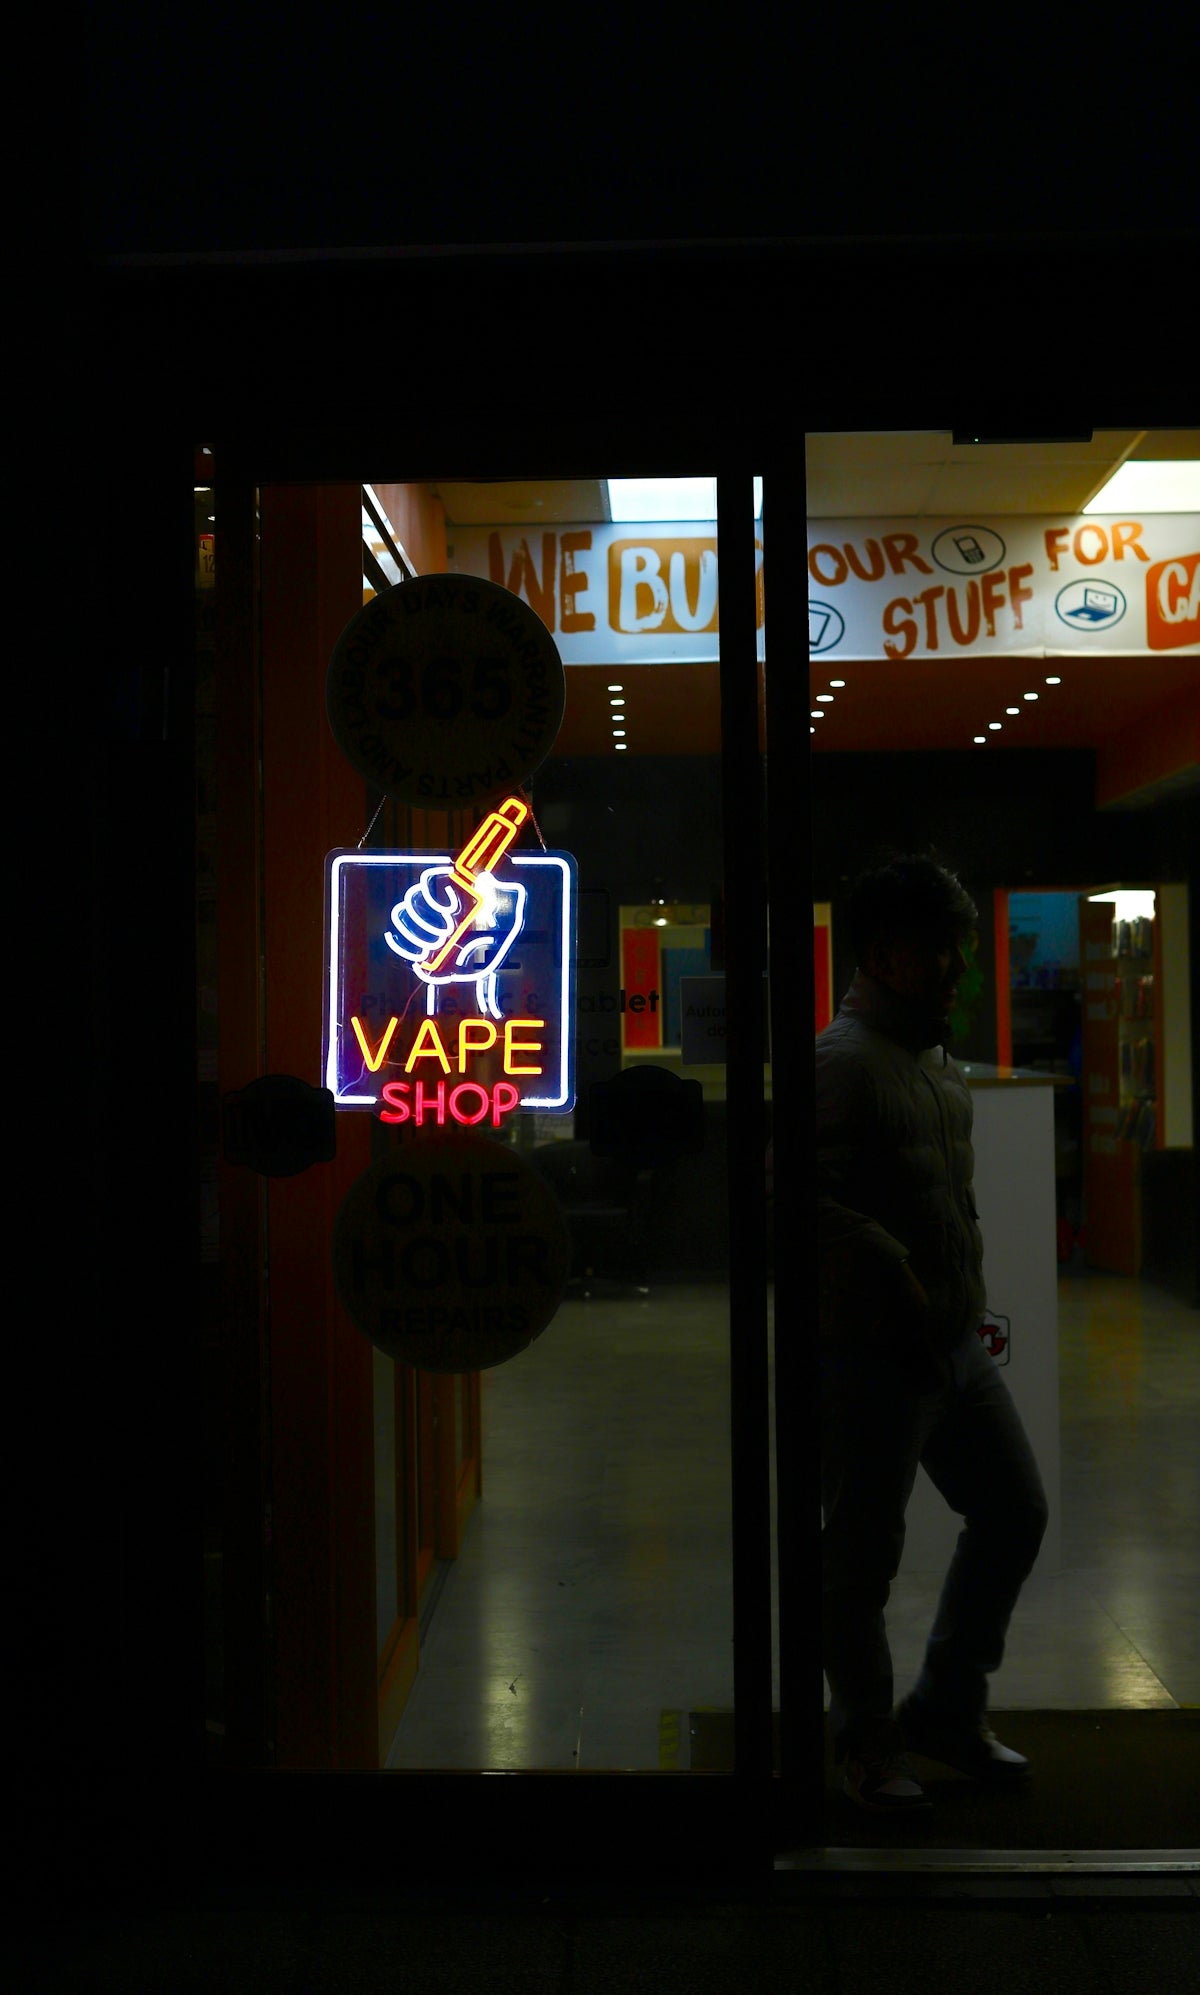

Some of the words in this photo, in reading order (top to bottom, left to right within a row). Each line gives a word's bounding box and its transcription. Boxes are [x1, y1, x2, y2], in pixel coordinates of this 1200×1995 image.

[401, 586, 482, 615] DAYS
[488, 530, 595, 634] WE
[619, 547, 763, 632] BU
[808, 532, 934, 586] OUR
[883, 563, 1034, 660] STUFF
[1044, 521, 1150, 571] FOR
[341, 606, 396, 730] LABOUR
[376, 657, 513, 721] 365
[487, 600, 551, 762] WARRANTY
[359, 733, 415, 787] AND
[418, 757, 513, 799] PARTS
[570, 989, 660, 1014] ablet
[350, 1016, 545, 1075] VAPE
[380, 1081, 519, 1127] SHOP
[376, 1172, 522, 1226] ONE
[352, 1235, 553, 1290] HOUR
[380, 1306, 530, 1333] REPAIRS
